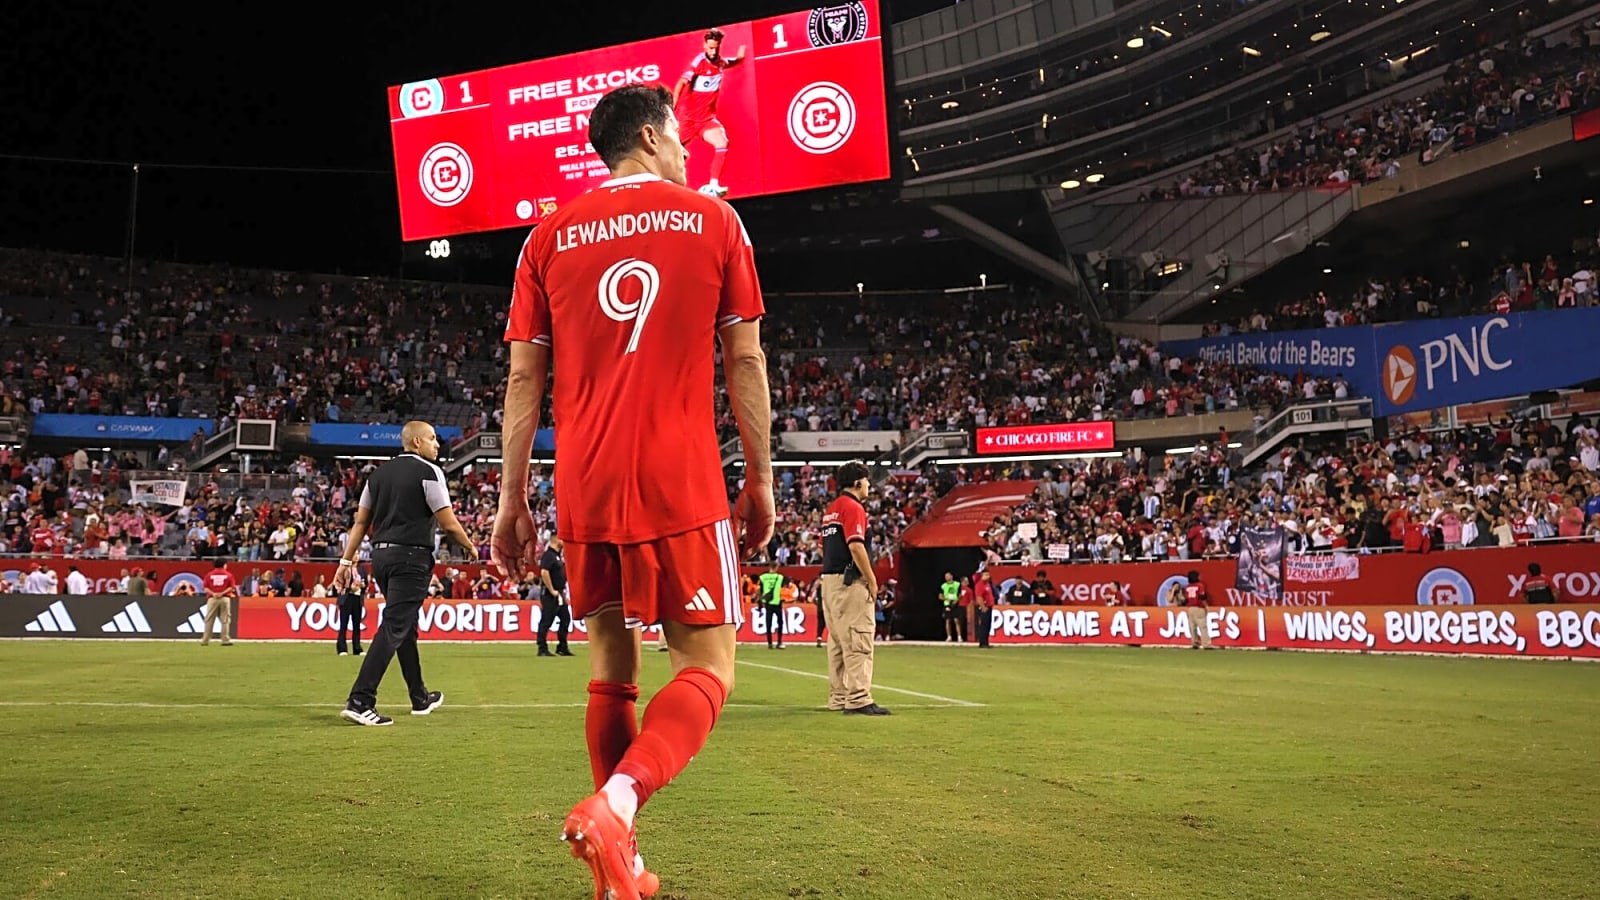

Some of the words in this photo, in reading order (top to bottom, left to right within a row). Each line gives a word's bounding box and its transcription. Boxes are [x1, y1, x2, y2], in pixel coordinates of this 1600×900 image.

[824, 9, 848, 18] MIAMI
[772, 24, 788, 49] 1
[460, 81, 473, 103] 1
[508, 79, 572, 105] FREE
[577, 64, 660, 93] KICKS
[508, 116, 572, 141] FREE
[556, 210, 704, 252] LEWANDOWSKI
[597, 257, 660, 356] 9
[1238, 341, 1267, 365] Bank
[1269, 340, 1283, 364] of
[1285, 339, 1307, 364] the
[1310, 339, 1356, 367] Bears
[1419, 317, 1513, 391] PNC
[110, 424, 154, 433] CARVANA
[1295, 411, 1311, 421] 101
[373, 431, 402, 440] CARVA
[995, 432, 1048, 446] CHICAGO
[1050, 431, 1075, 443] FIRE
[1077, 430, 1092, 441] FC
[1507, 572, 1600, 597] xrox
[378, 602, 519, 632] VORITE
[990, 609, 1100, 637] PREGAME
[1110, 610, 1149, 638] AT
[1159, 607, 1240, 639] JAE'S
[1284, 609, 1375, 647] WINGS,
[1384, 610, 1526, 651] BURGERS,
